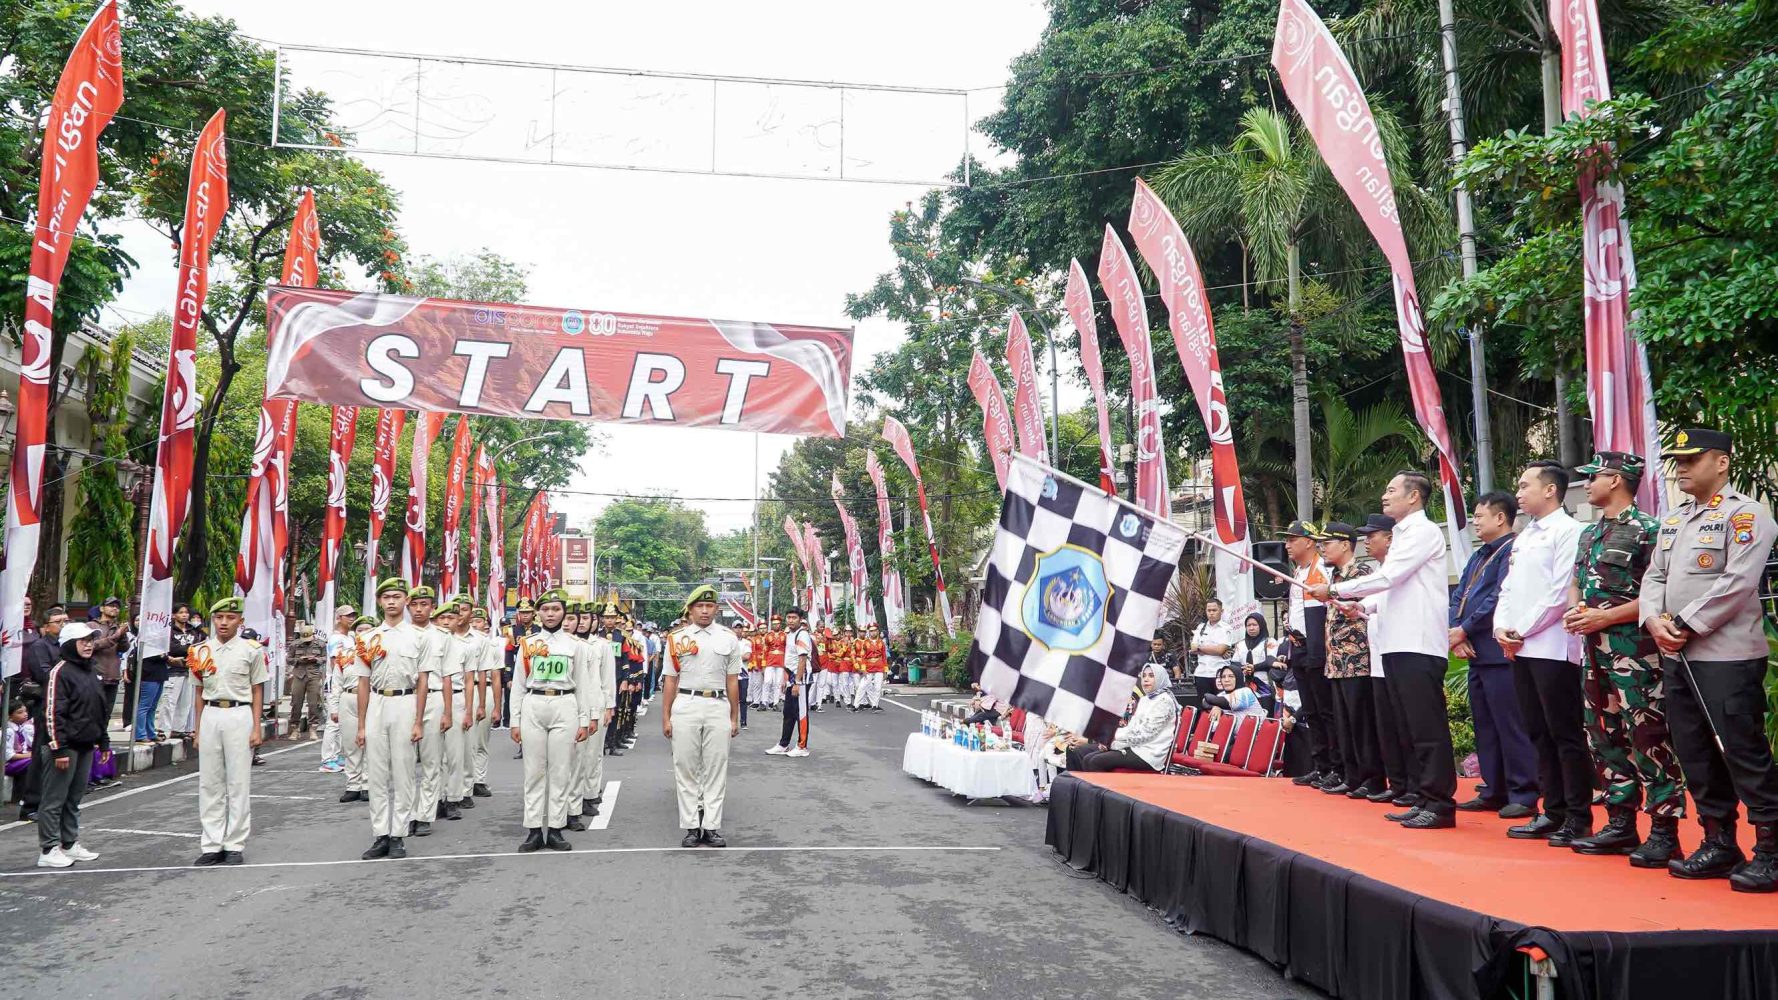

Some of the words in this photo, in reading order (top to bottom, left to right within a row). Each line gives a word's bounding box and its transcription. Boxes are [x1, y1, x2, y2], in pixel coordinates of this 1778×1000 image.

[589, 312, 617, 336] 80
[360, 334, 770, 425] START
[1699, 523, 1724, 533] POLRI
[536, 660, 564, 675] 410
